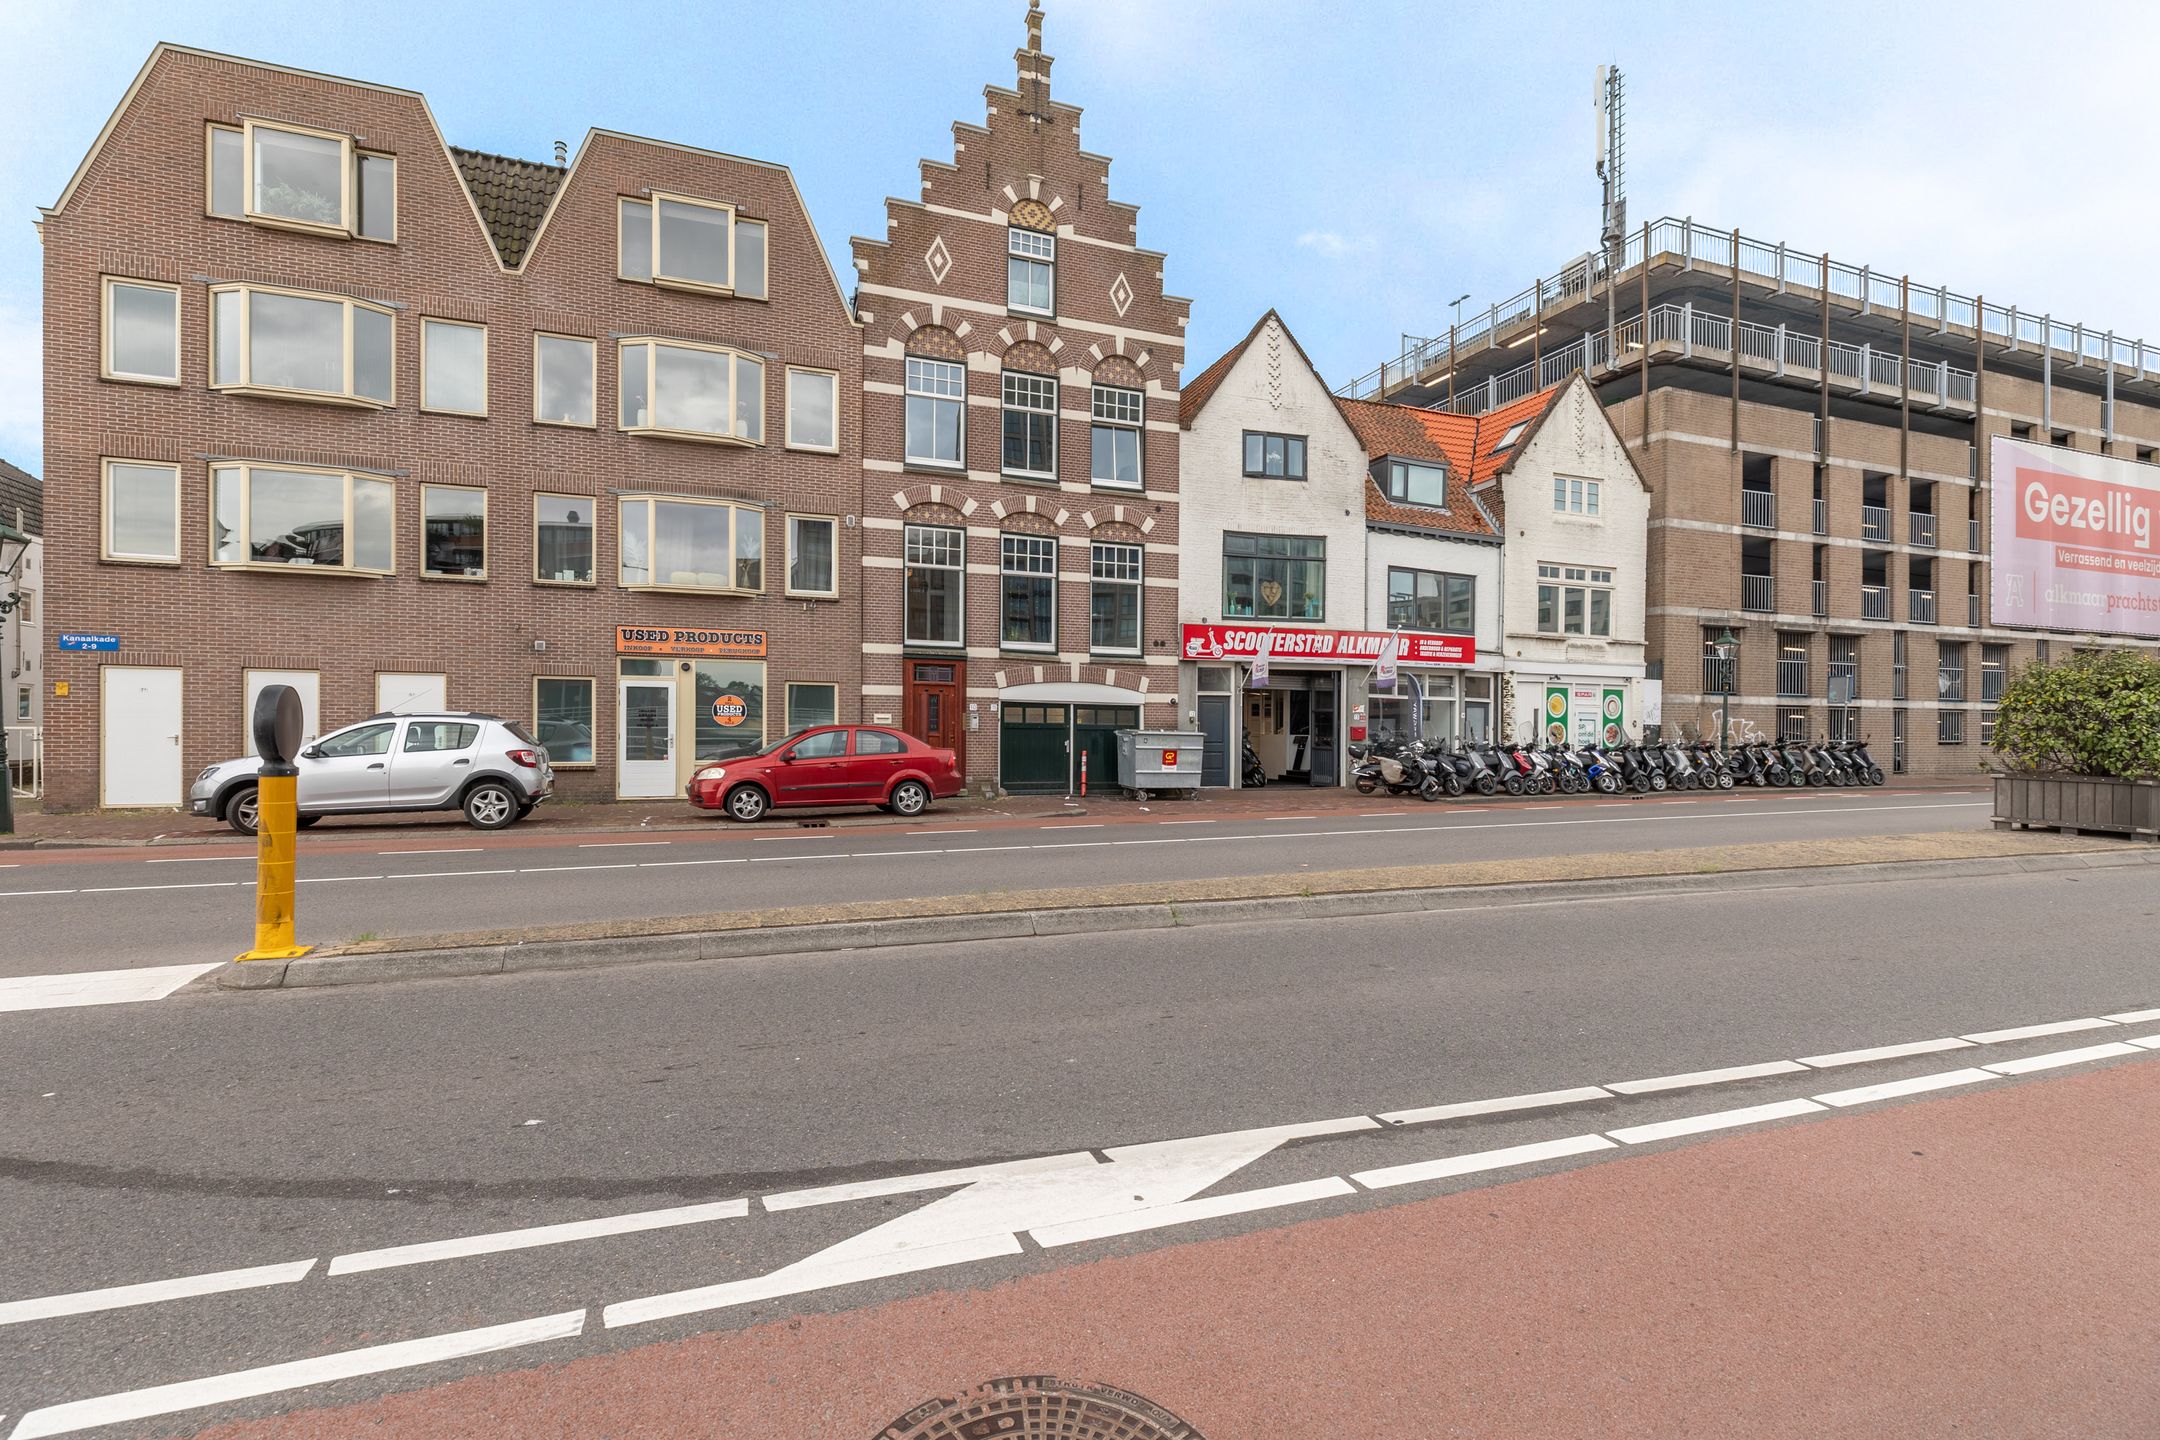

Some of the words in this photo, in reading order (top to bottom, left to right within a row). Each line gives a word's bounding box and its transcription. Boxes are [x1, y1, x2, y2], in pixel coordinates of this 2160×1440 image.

[2024, 481, 2150, 549] Gezellig
[2058, 549, 2112, 568] Verrassend
[2114, 559, 2125, 569] en
[620, 629, 670, 642] USED
[673, 630, 763, 645] PRODUCTS
[1223, 630, 1334, 653] SCOOTERSTAD
[1336, 635, 1410, 656] ALKMAR
[716, 705, 743, 713] USED
